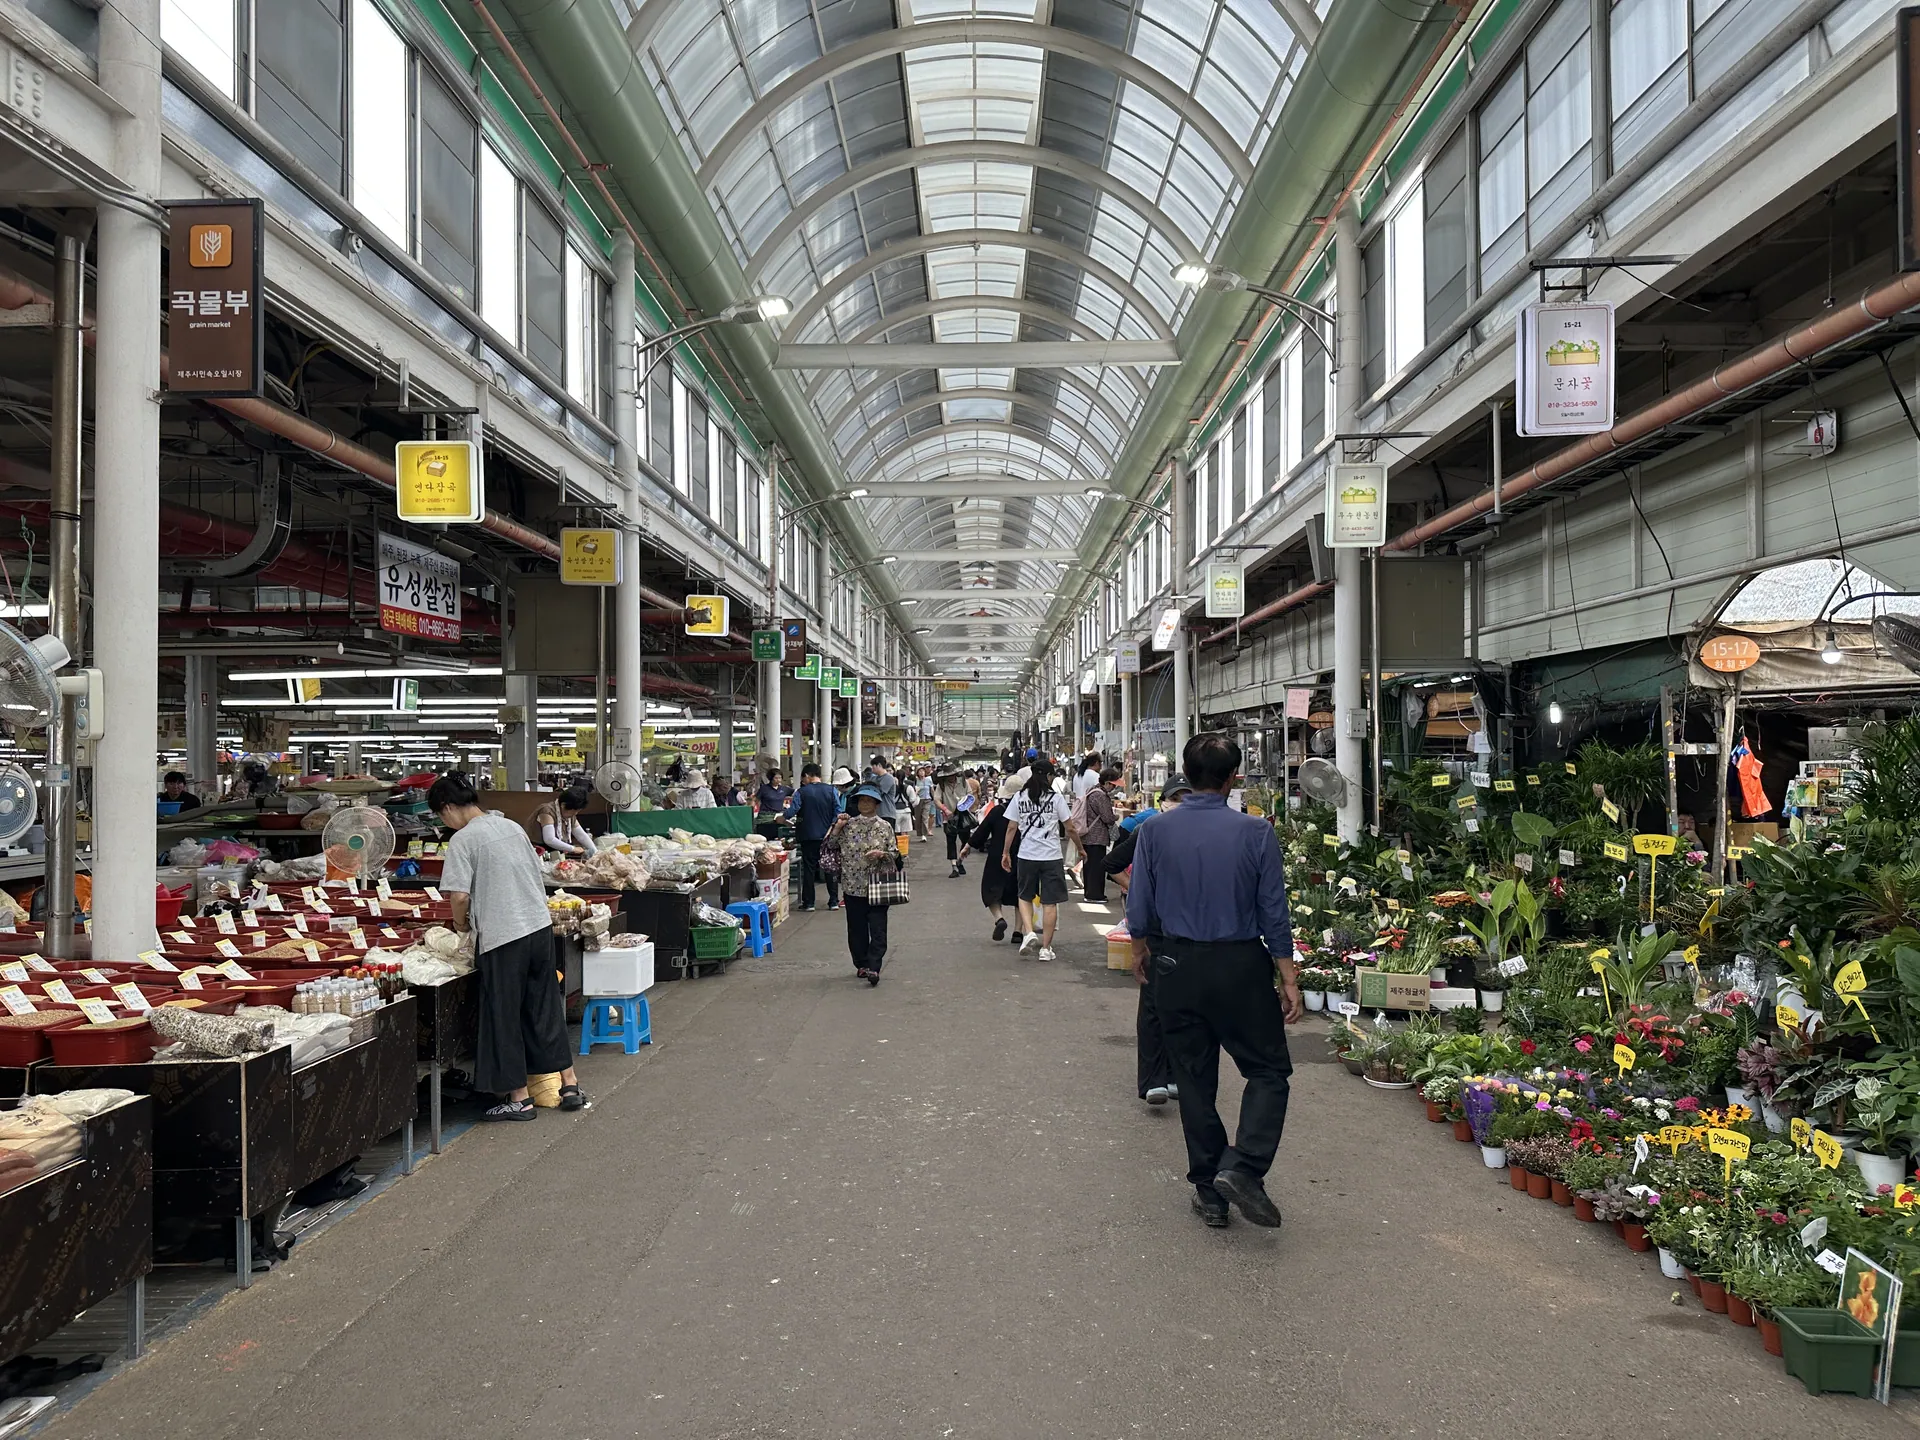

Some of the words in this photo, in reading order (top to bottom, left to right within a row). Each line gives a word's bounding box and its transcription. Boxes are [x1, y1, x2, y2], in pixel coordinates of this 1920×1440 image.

[171, 289, 249, 316] 곡물부
[189, 321, 207, 329] grain
[177, 369, 243, 379] 제주시민속오일시장
[1554, 376, 1593, 391] 운자꽃
[383, 564, 457, 616] 유성쌀집
[382, 608, 395, 628] 전국
[1711, 641, 1749, 657] 15-17
[1831, 728, 1837, 737] 7
[691, 741, 716, 753] 야채
[1389, 986, 1426, 997] 제주청귤차
